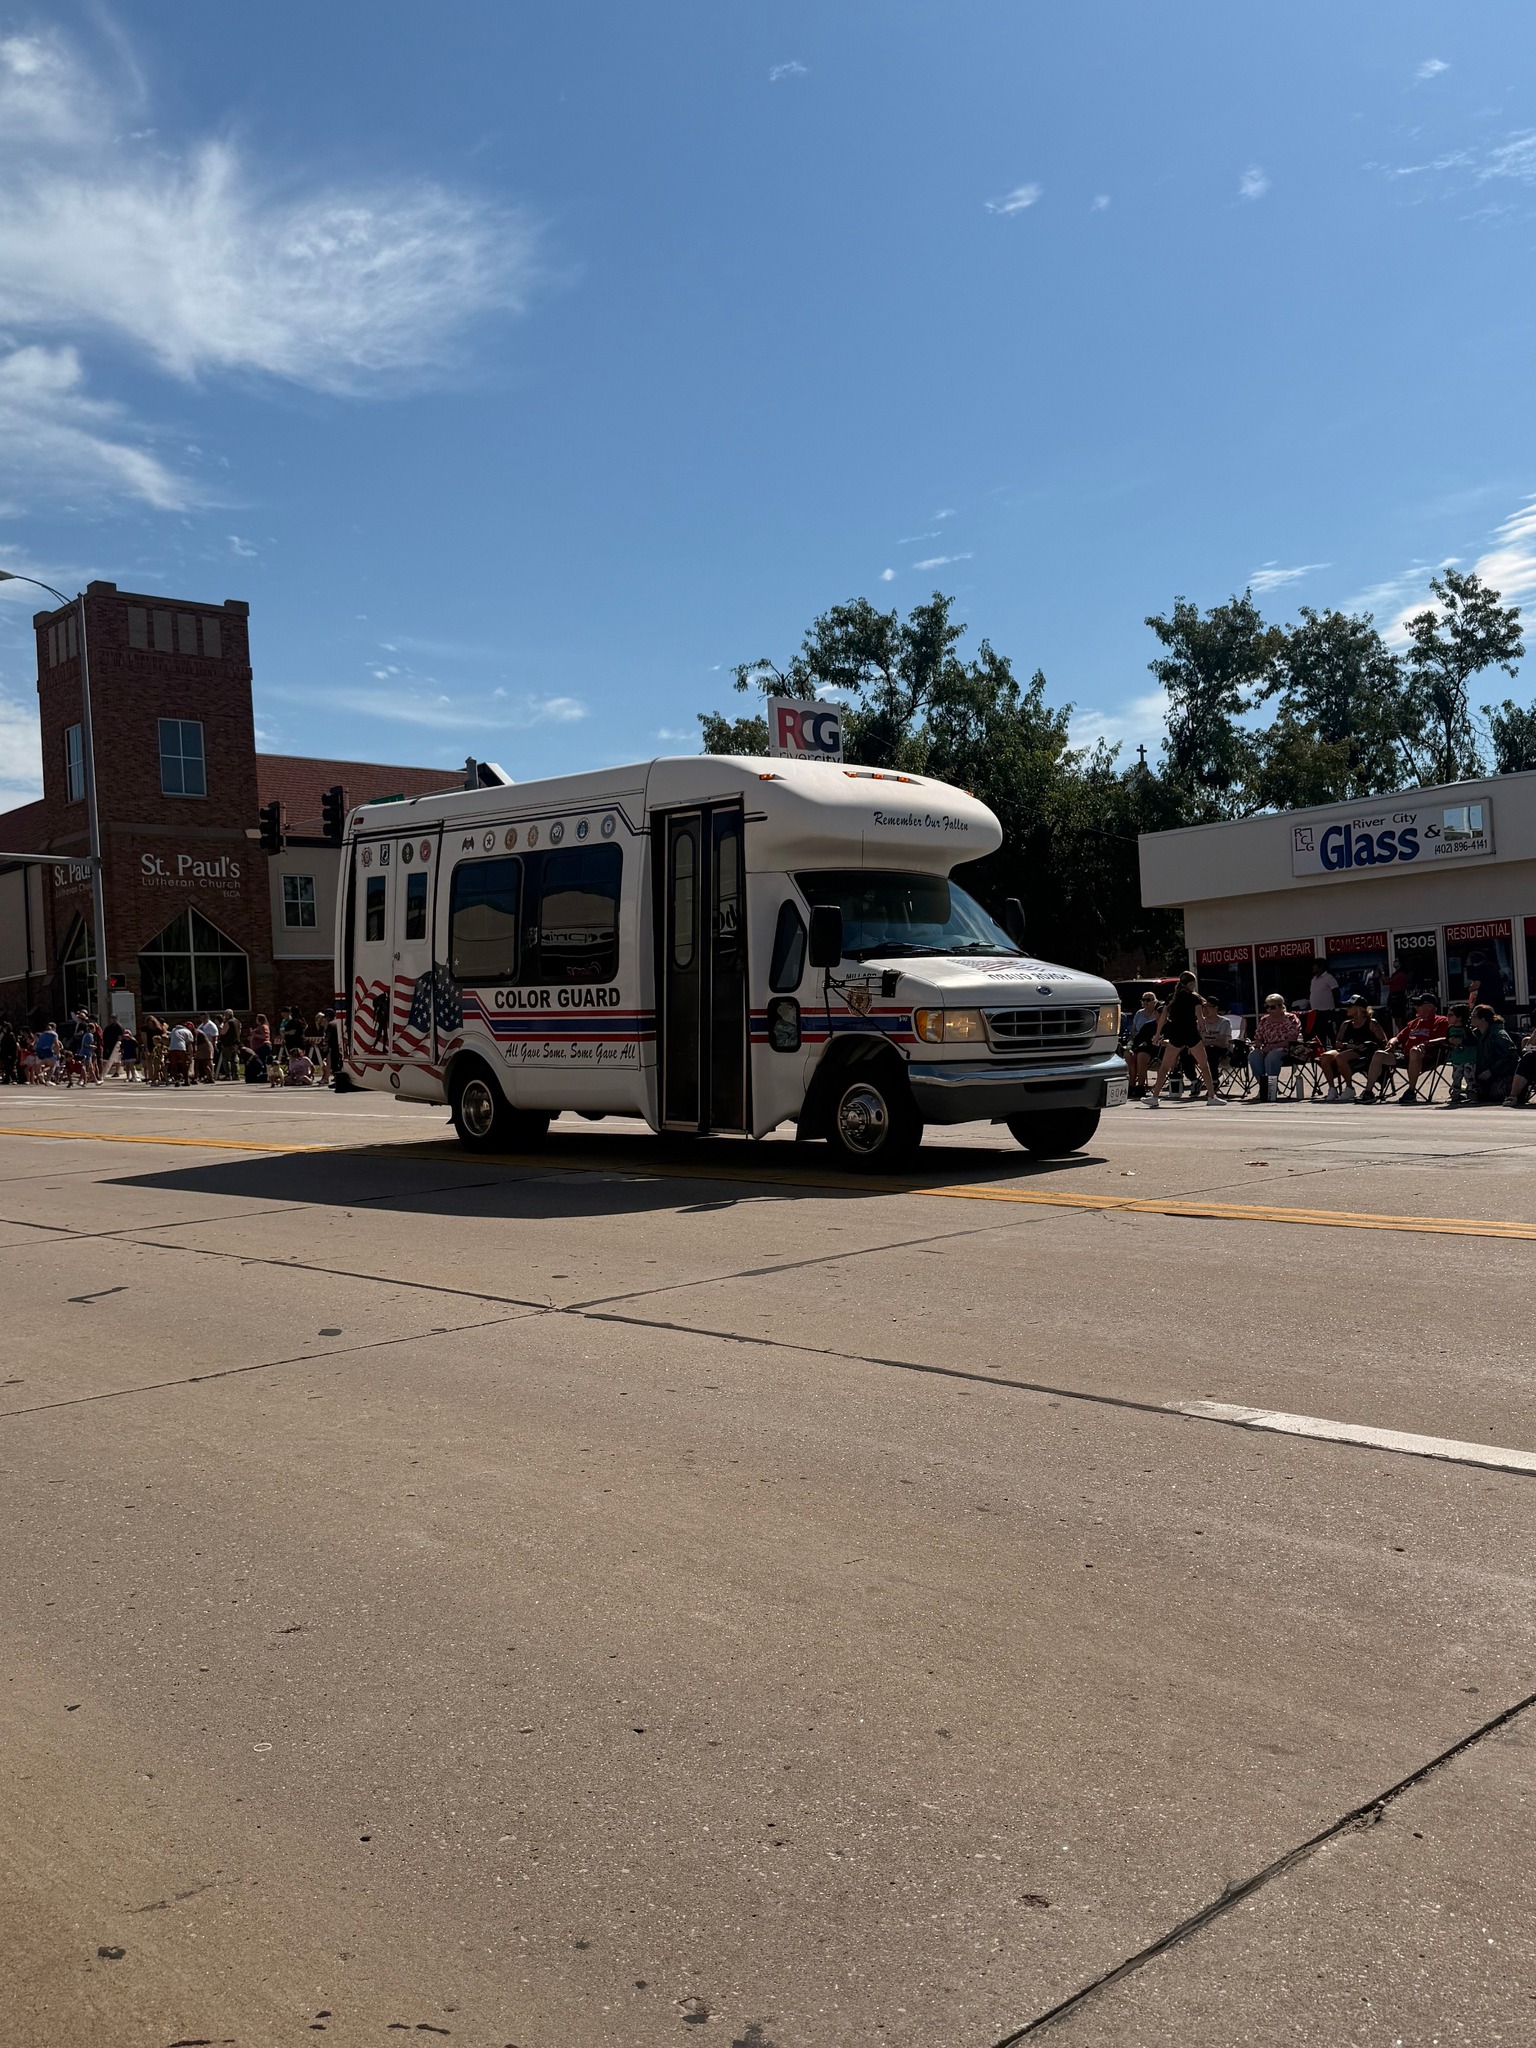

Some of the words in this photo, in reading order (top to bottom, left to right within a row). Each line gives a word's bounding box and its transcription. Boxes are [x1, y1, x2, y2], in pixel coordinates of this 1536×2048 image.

[777, 707, 840, 752] RCG
[873, 811, 922, 827] Remember
[924, 814, 941, 829] Our
[942, 815, 969, 831] Fallen
[1353, 817, 1386, 829] River
[1392, 813, 1418, 825] City
[1319, 824, 1420, 871] Glass
[1424, 824, 1441, 839] &
[1434, 843, 1453, 855] (402)
[1454, 839, 1488, 852] 896-4141
[141, 853, 171, 876] St.
[177, 854, 241, 878] Paul's
[54, 865, 68, 887] St.
[142, 877, 195, 888] Lutheran
[199, 878, 241, 889] Church
[223, 890, 241, 898] ELCA
[1446, 923, 1511, 941] RESIDENTIAL
[1259, 945, 1279, 958] CHIP
[1280, 942, 1311, 956] REPAIR
[1329, 935, 1386, 951] COMMERCIAL
[1394, 935, 1436, 949] 13305
[1201, 950, 1223, 963] AUTO
[1223, 948, 1249, 961] GLASS
[494, 990, 551, 1009] COLOR
[557, 988, 621, 1008] GUARD
[505, 1043, 519, 1058] All
[520, 1043, 541, 1062] Gave
[570, 1042, 593, 1059] Some
[596, 1043, 618, 1063] Gave
[620, 1043, 636, 1060] All
